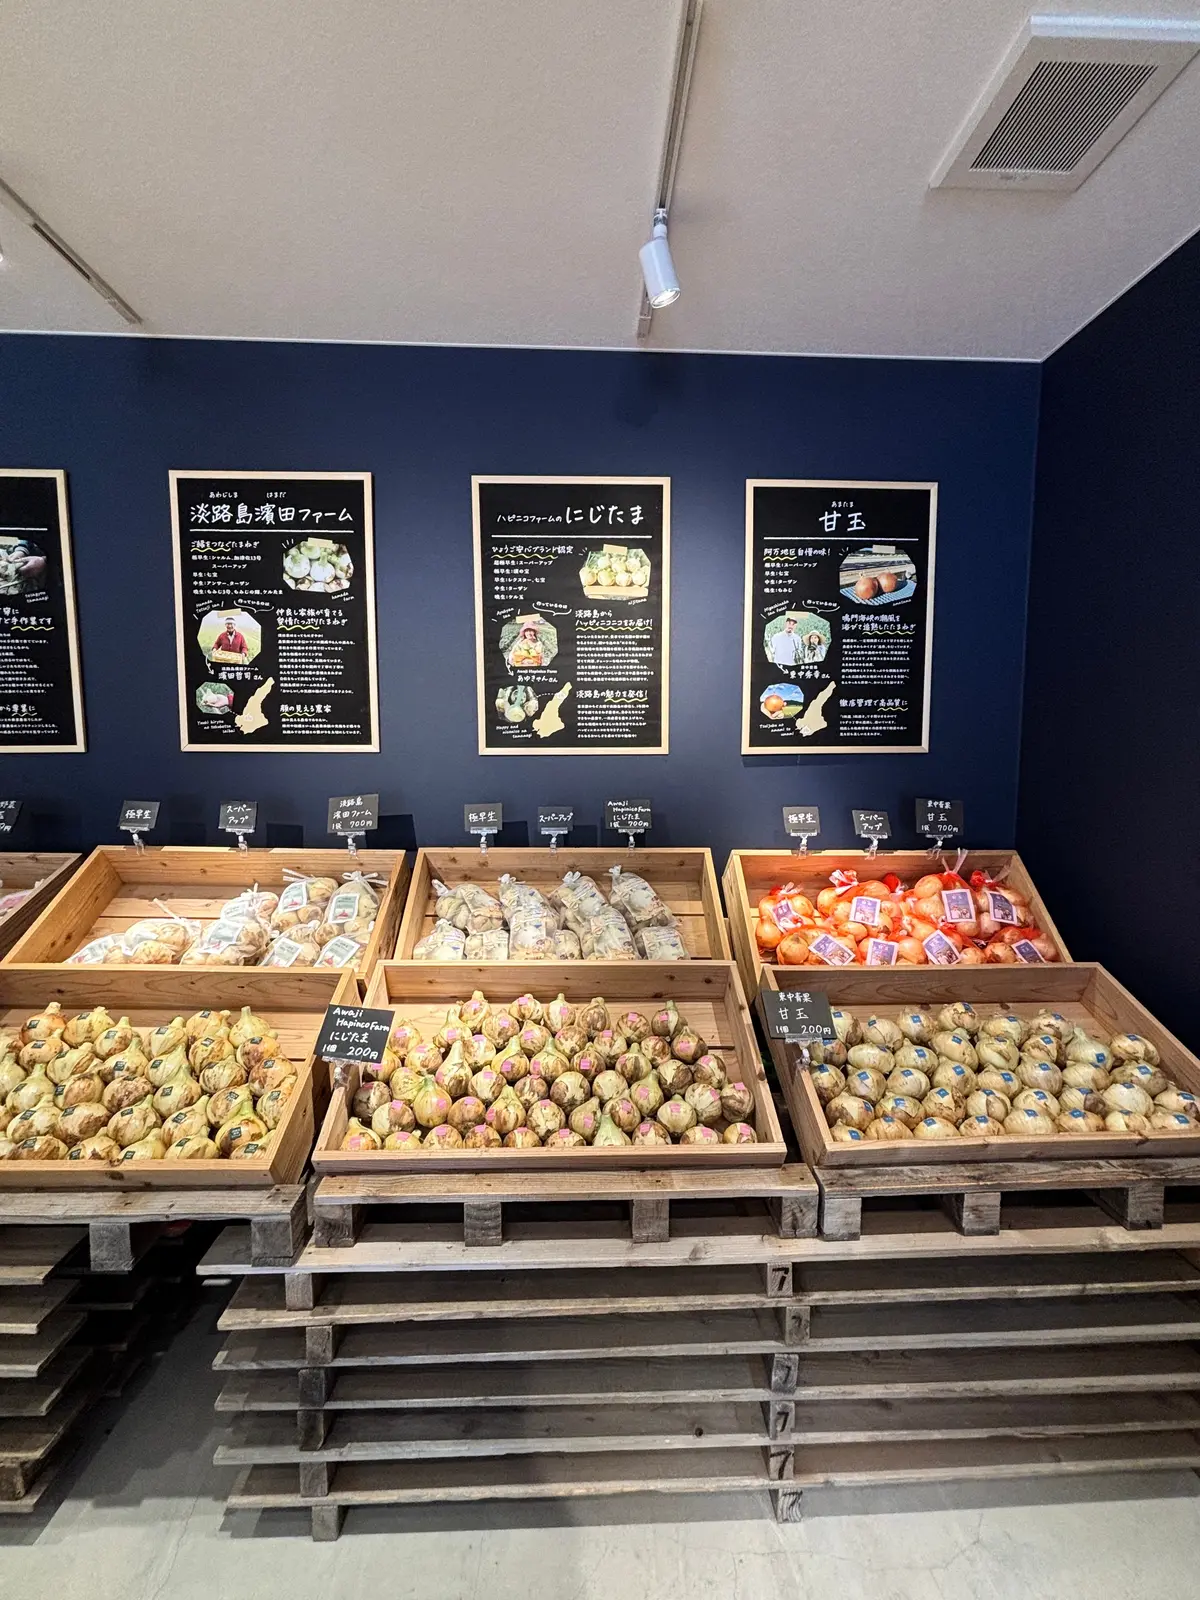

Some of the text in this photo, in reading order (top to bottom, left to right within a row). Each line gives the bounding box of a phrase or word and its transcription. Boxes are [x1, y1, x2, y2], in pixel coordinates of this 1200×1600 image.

[209, 491, 287, 499] あわじしま はまだ
[190, 503, 353, 525] 淡路島濱田ファーム
[819, 510, 866, 532] 甘玉
[276, 608, 343, 617] 仲良し家族が育てる
[575, 609, 613, 618] 淡路島から
[340, 796, 363, 808] 淡路島
[125, 808, 152, 819] 極早生
[226, 804, 252, 814] スーパー
[228, 815, 249, 824] アップ
[468, 810, 498, 823] 極早生
[539, 812, 574, 823] スーパーアップ
[613, 813, 640, 821] にじたま
[788, 812, 816, 824] 極早生
[860, 813, 884, 821] スーパー
[927, 812, 948, 822] 甘玉
[350, 820, 373, 828] 700円
[862, 822, 883, 831] アップ
[937, 824, 959, 833] 700円
[778, 991, 812, 1003] 東中青果
[333, 1007, 364, 1018] Awaji
[778, 1007, 809, 1020] 甘玉
[801, 1025, 831, 1035] 200円
[329, 1031, 369, 1043] にじたま
[322, 1044, 379, 1060] 1個 200円
[772, 1267, 789, 1291] 7
[777, 1411, 789, 1432] 7
[770, 1450, 792, 1480] 7
